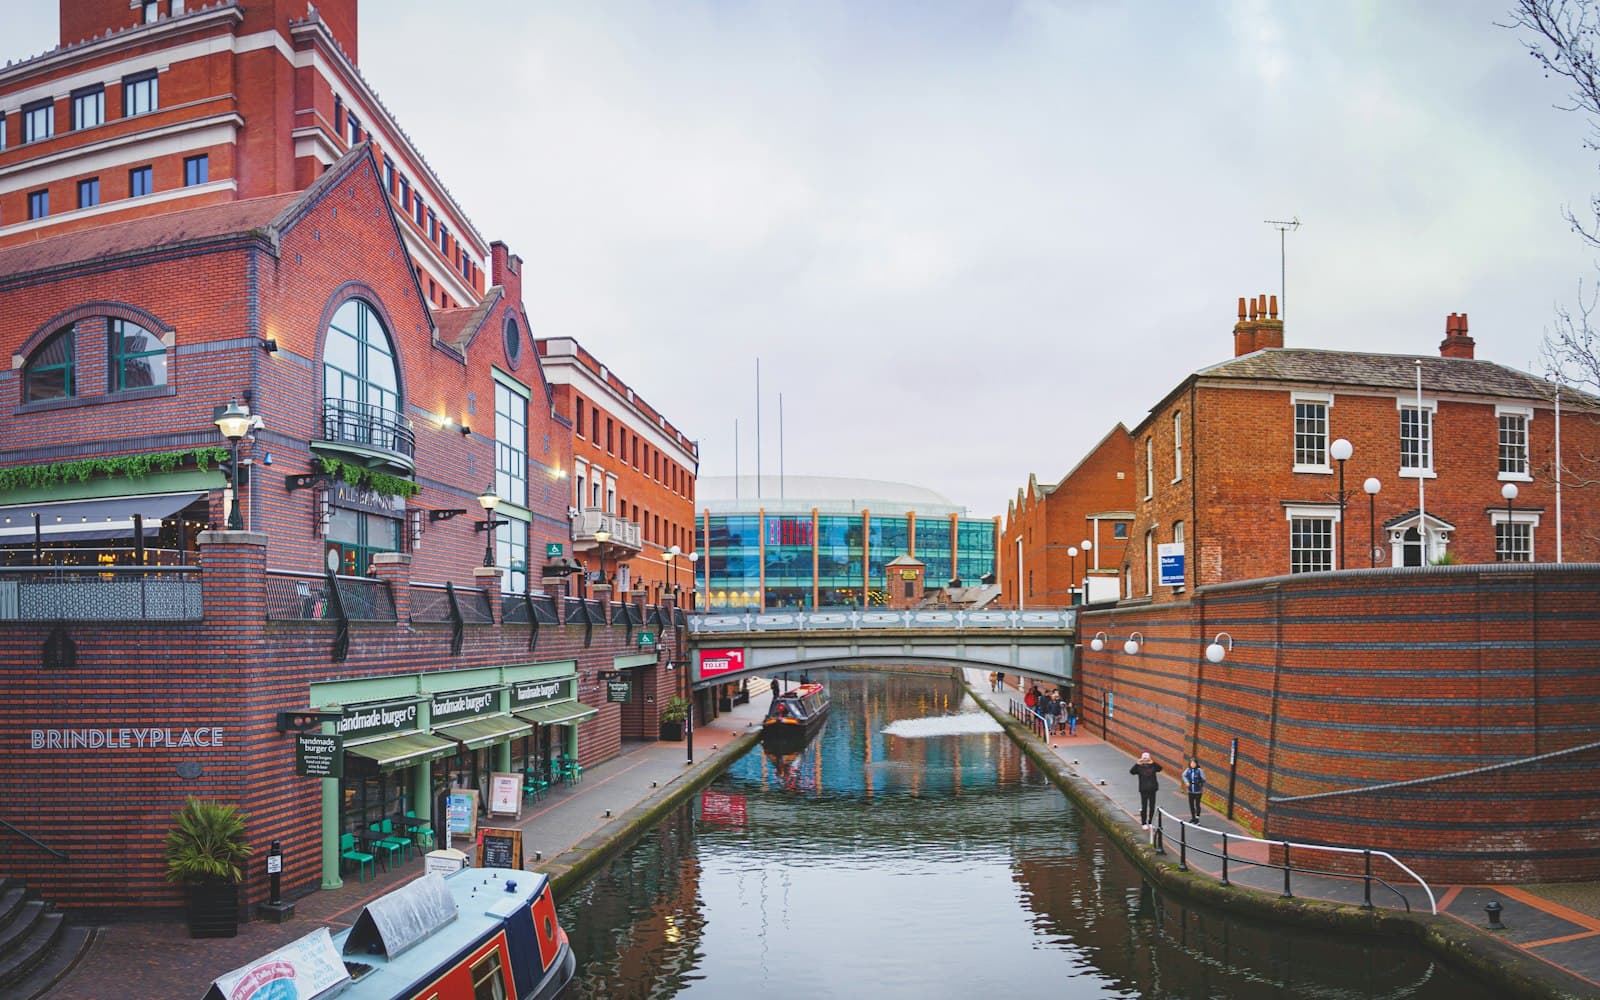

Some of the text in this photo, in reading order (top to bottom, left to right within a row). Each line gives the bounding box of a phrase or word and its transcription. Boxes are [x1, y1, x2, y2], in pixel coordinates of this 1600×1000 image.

[339, 488, 355, 502] ALL
[518, 685, 541, 700] handmade
[540, 684, 556, 699] burger
[432, 697, 466, 716] handmade
[465, 695, 485, 713] burger
[382, 708, 407, 727] burger
[31, 727, 224, 749] BRINDLEYPLACE
[300, 736, 334, 745] handmade
[305, 744, 327, 753] burger
